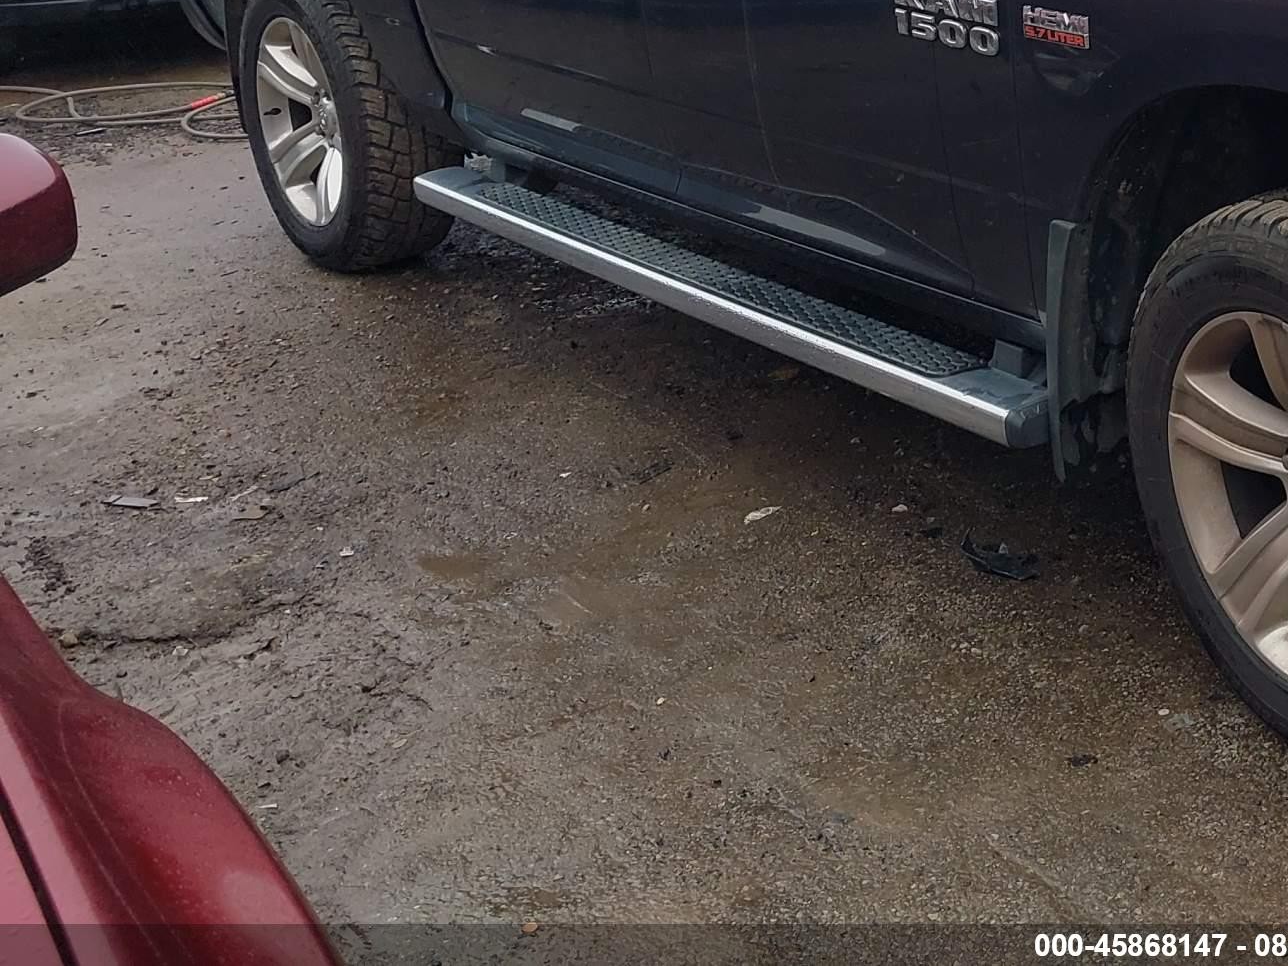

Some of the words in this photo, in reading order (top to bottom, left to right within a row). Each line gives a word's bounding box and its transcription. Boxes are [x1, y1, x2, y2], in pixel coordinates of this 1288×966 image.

[894, 8, 1000, 57] 1500
[1023, 5, 1089, 34] HEMI
[1025, 25, 1046, 39] 5.7
[1047, 29, 1085, 47] LITER
